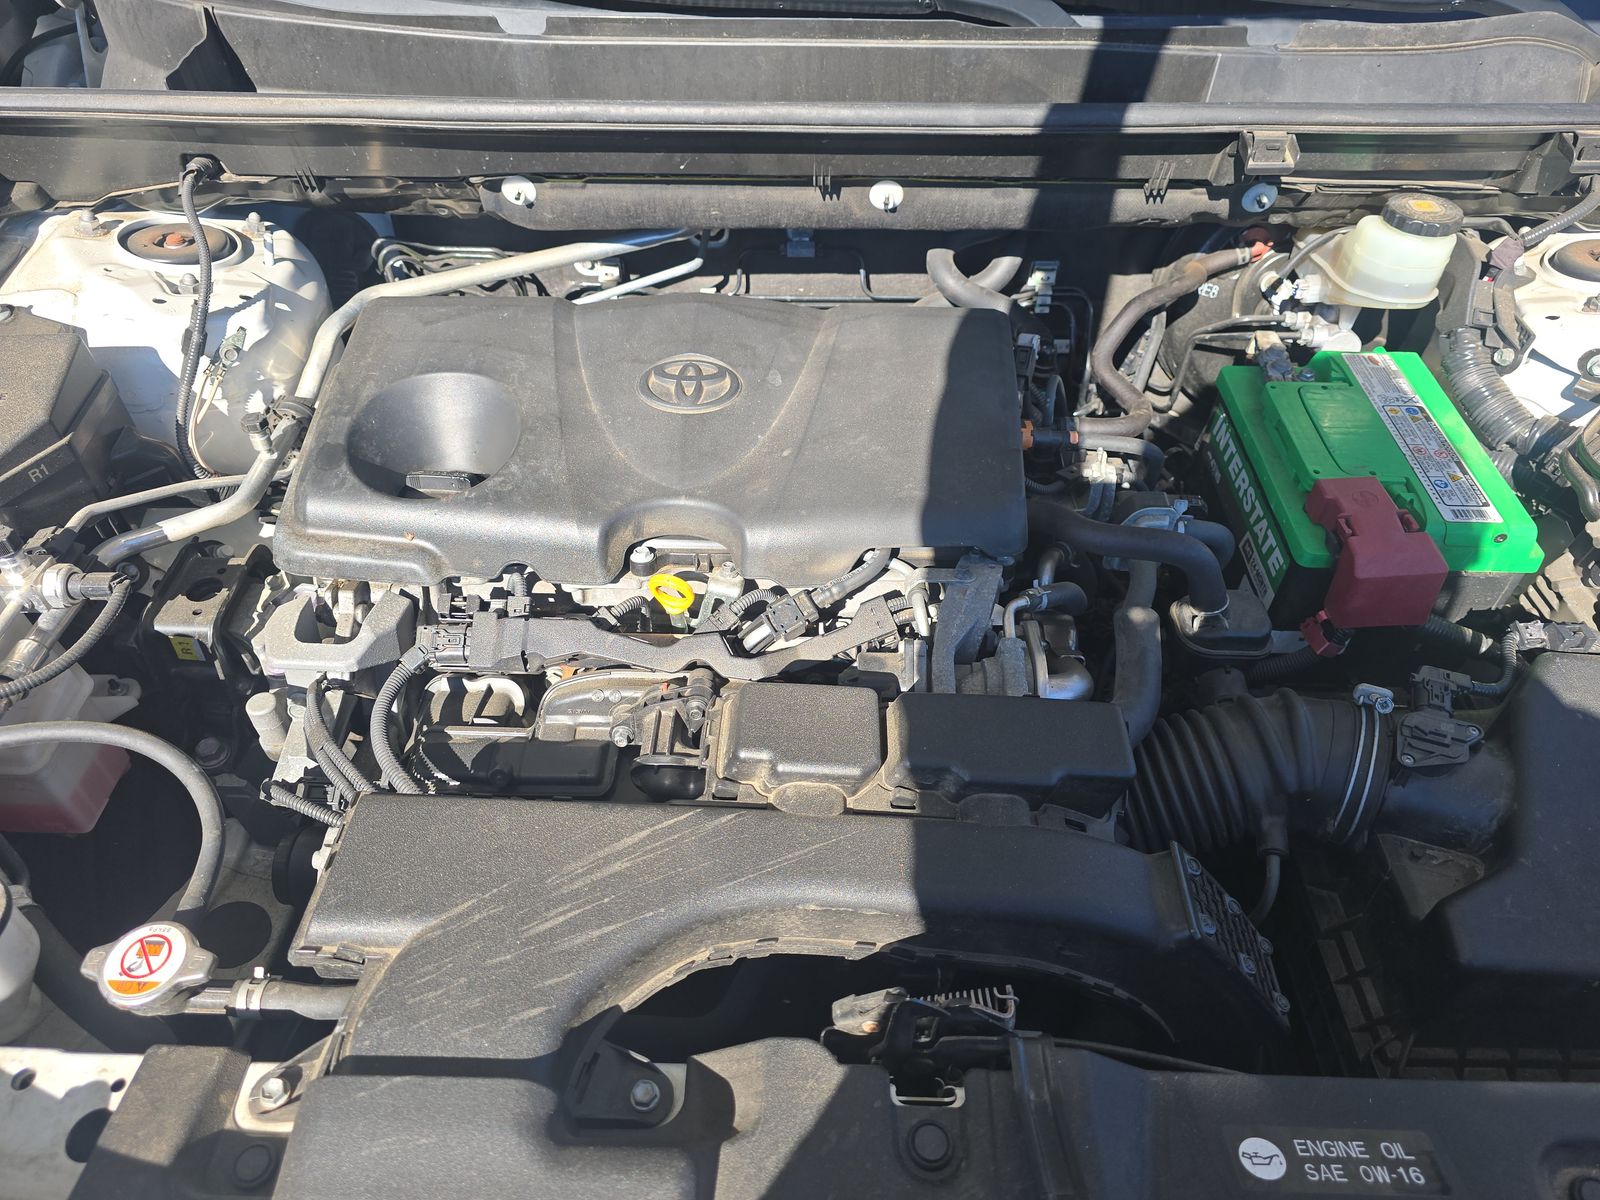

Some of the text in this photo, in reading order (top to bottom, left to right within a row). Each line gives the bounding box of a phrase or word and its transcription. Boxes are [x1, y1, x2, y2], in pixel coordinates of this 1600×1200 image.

[28, 463, 49, 483] R1
[1212, 415, 1284, 577] INTERSTATE
[178, 641, 193, 656] R1
[1293, 1139, 1415, 1160] ENGINE OIL
[1304, 1163, 1426, 1185] SAE 0W-16
